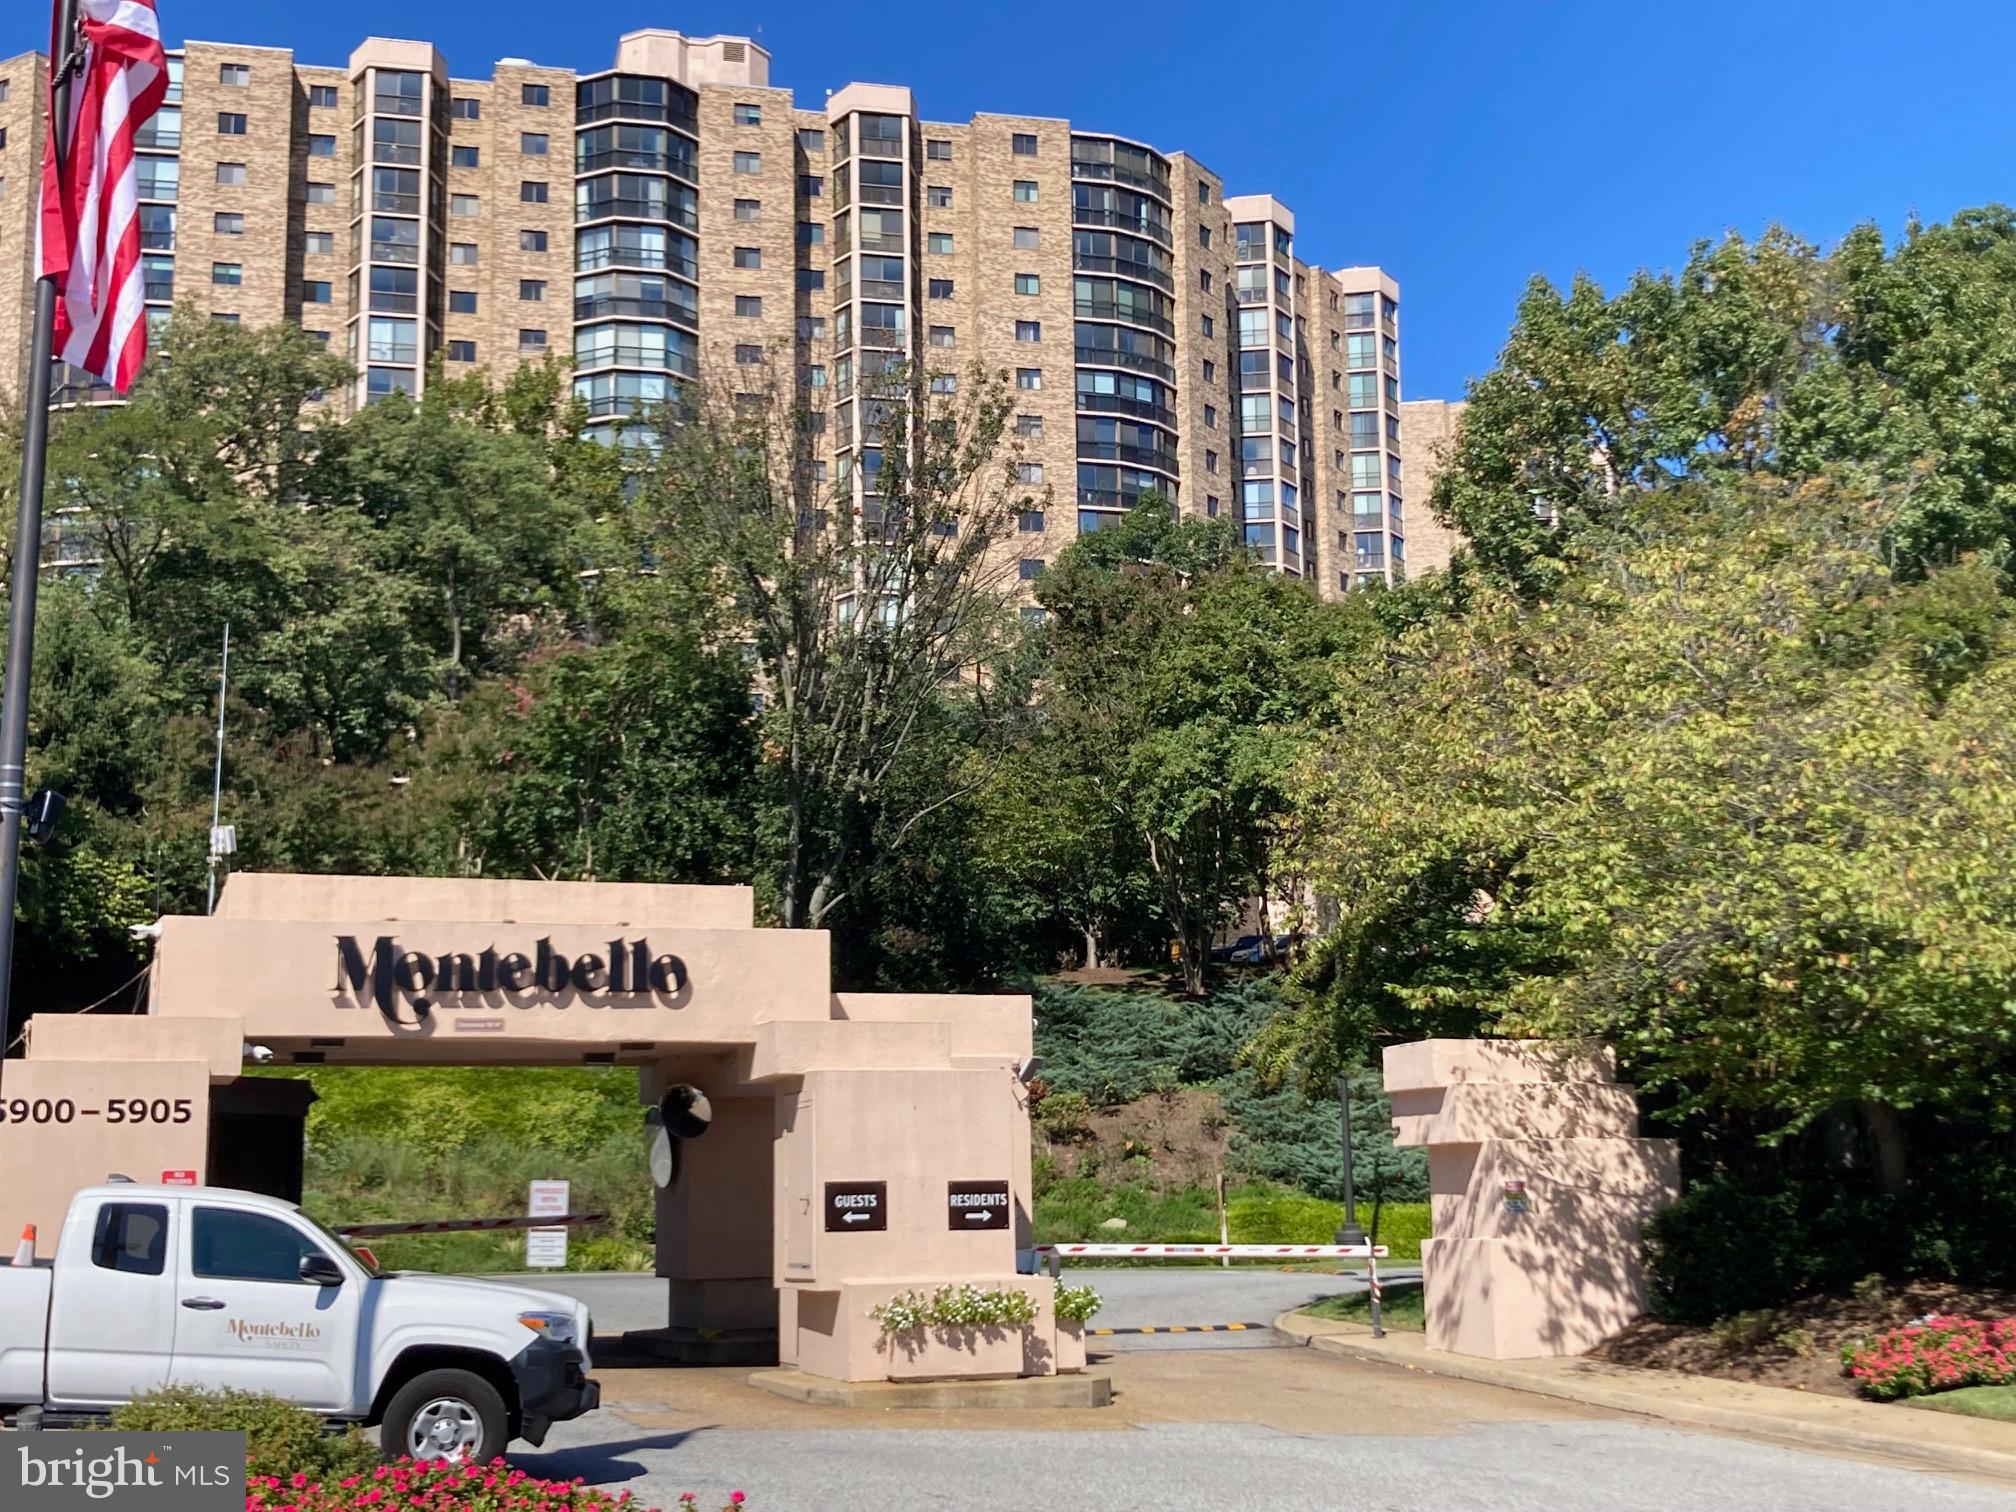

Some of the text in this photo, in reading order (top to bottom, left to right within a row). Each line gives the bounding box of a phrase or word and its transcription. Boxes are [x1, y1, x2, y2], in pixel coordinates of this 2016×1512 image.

[328, 934, 688, 1025] Montebello
[834, 1194, 878, 1208] GUESTS
[950, 1193, 1008, 1207] RESIDENTS
[226, 1319, 320, 1342] Montebello
